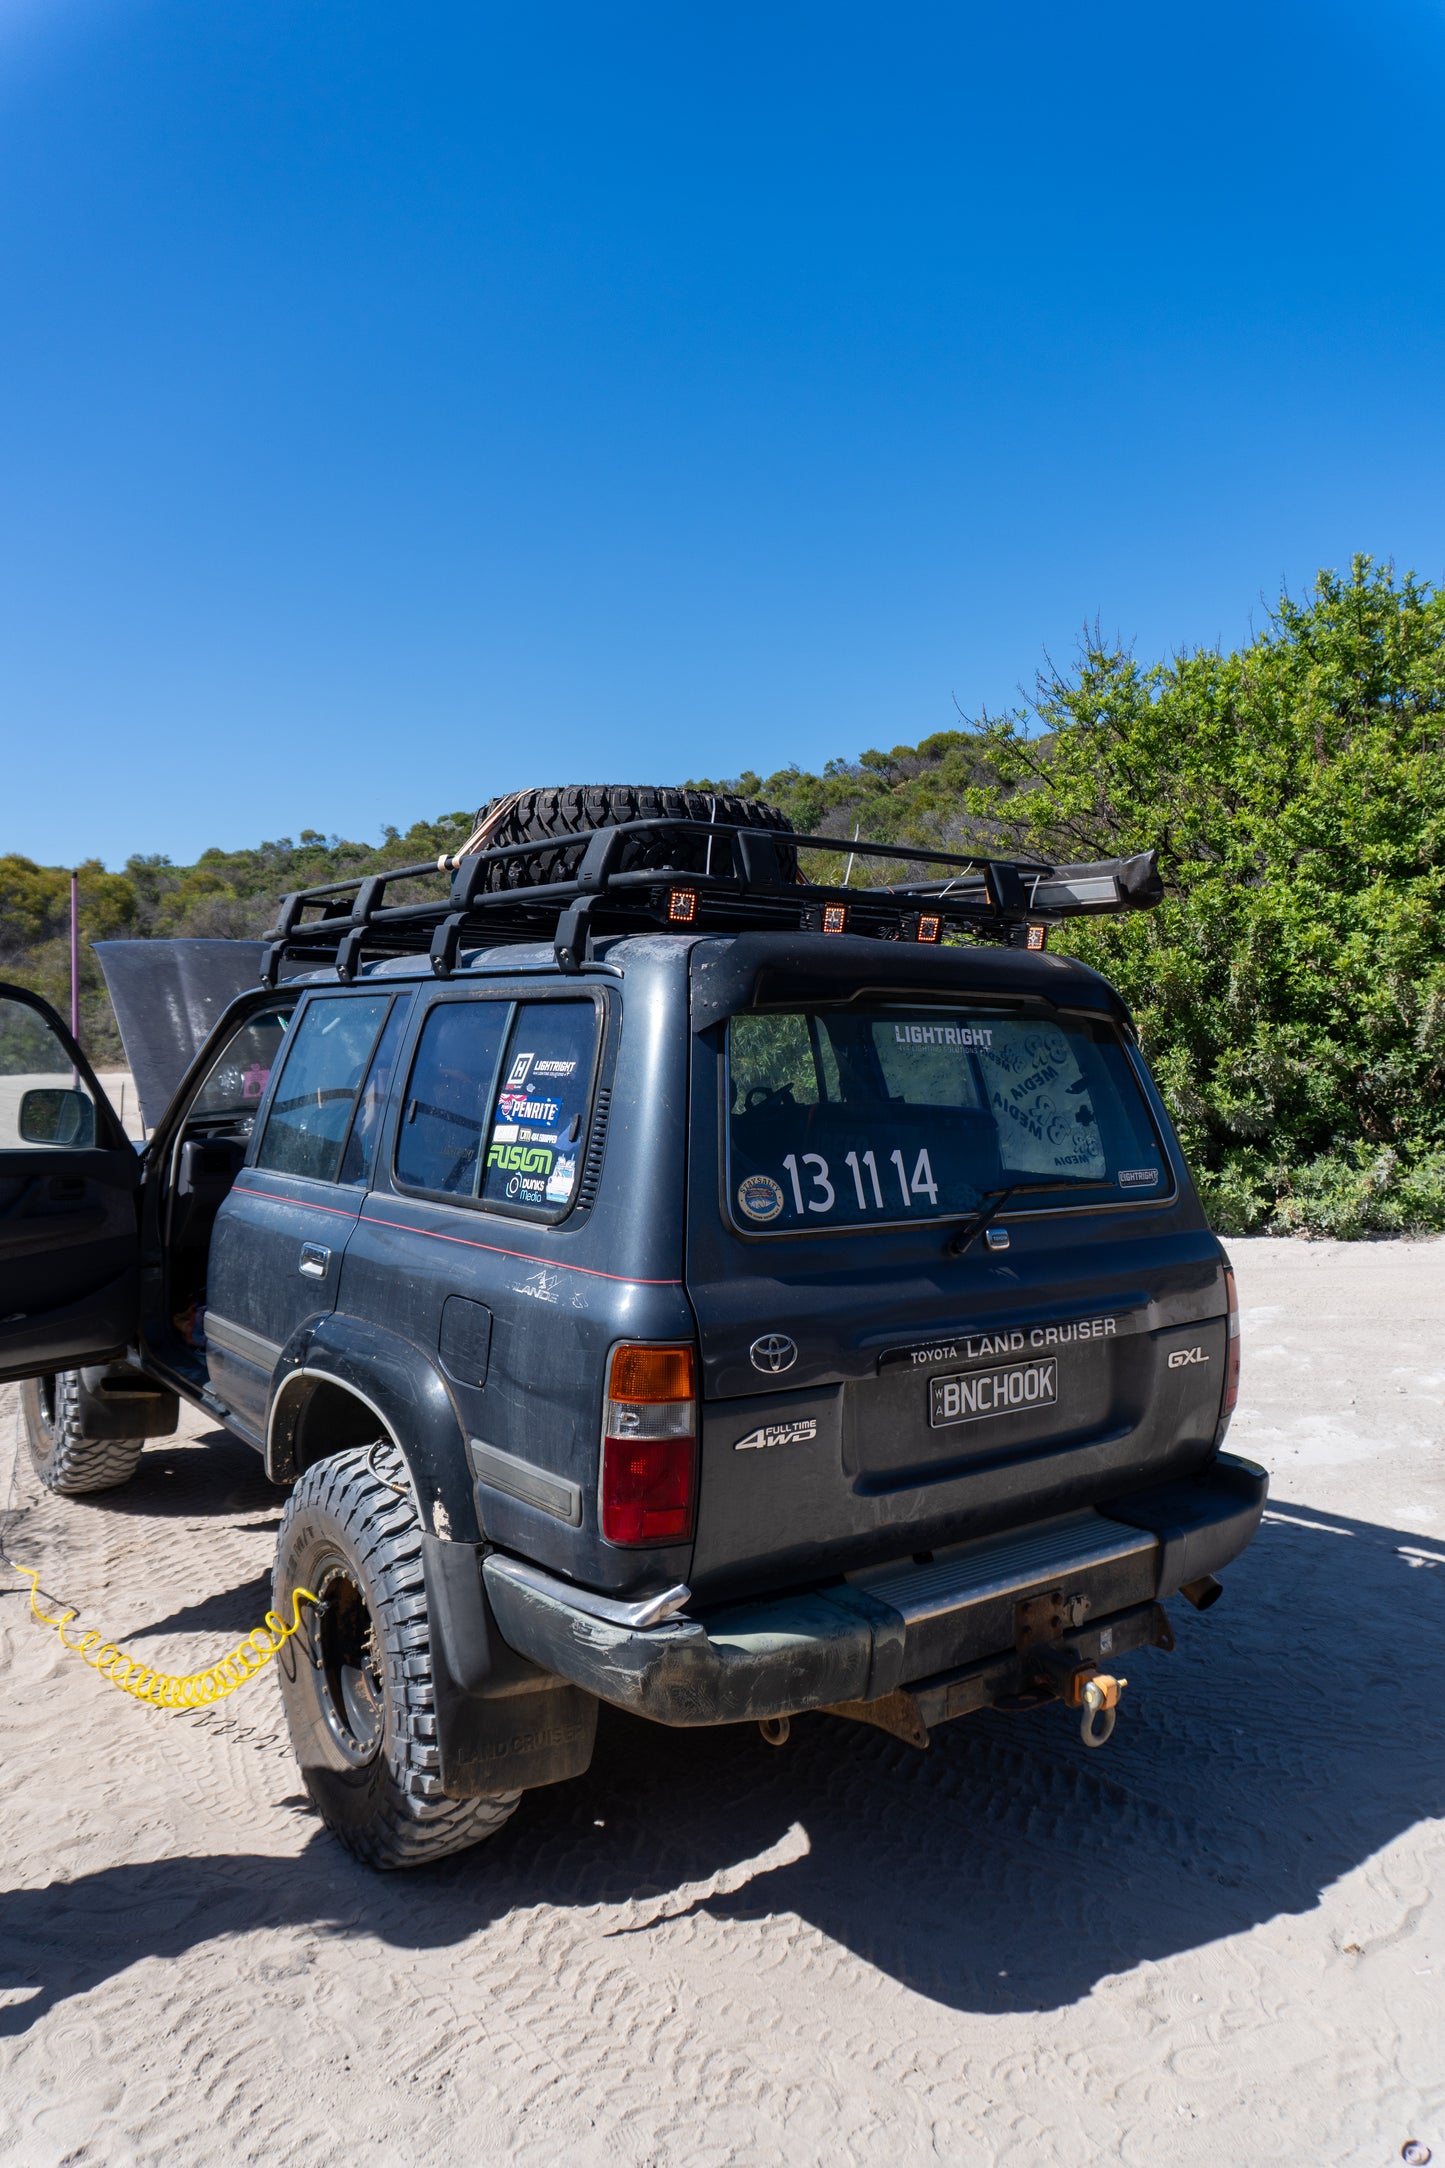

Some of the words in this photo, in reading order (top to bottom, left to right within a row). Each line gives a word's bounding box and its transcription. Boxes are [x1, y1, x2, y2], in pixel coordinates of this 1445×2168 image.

[894, 1025, 993, 1046] LIGHTRIGHT
[533, 1060, 577, 1072] LIGHTRIGHT
[511, 1099, 558, 1121] PENRITE
[487, 1145, 553, 1175] FUSION
[740, 1178, 756, 1193] STAY
[781, 1153, 836, 1214] 13
[845, 1150, 884, 1210] 11
[890, 1148, 938, 1207] 14
[1119, 1170, 1157, 1182] LIGHTRIGHT
[910, 1347, 958, 1364] TOYOTA
[966, 1333, 1025, 1358] LAND
[1030, 1318, 1116, 1348] CRUISER
[1168, 1346, 1210, 1369] GXL
[943, 1365, 1054, 1417] BNCHOOK
[735, 1427, 817, 1450] 4WD
[765, 1424, 793, 1436] FULL
[792, 1419, 817, 1431] TIME
